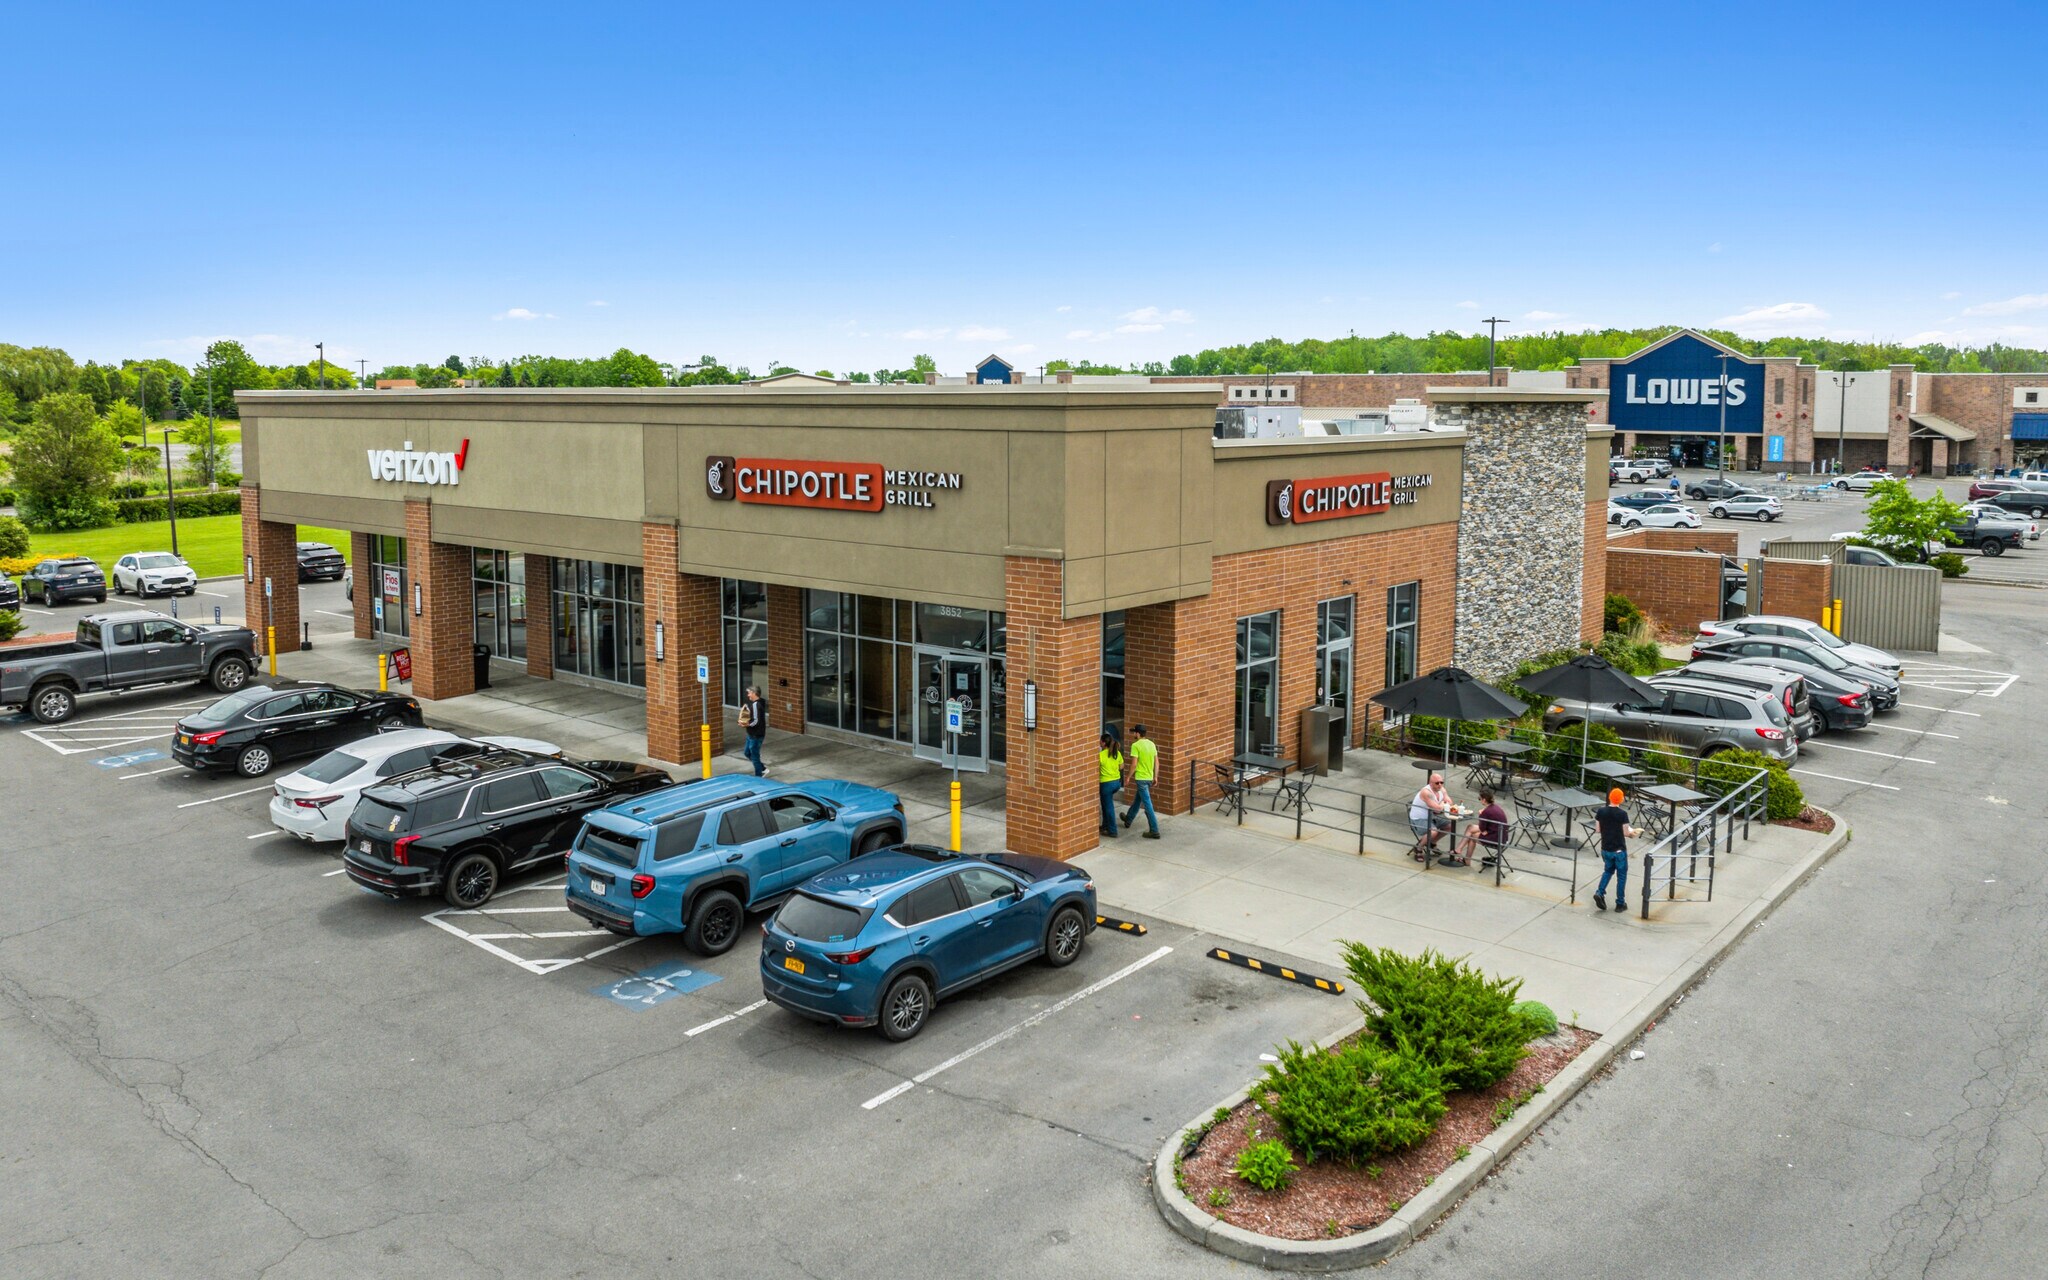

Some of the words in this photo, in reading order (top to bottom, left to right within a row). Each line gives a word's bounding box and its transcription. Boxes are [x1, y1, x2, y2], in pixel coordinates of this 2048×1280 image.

[367, 440, 459, 485] verizon
[738, 467, 871, 501] CHIPOTLE
[885, 470, 962, 489] MEXICAN
[1394, 474, 1433, 489] MEXICAN
[885, 490, 934, 507] GRILL
[1302, 481, 1391, 514] CHIPOTLE
[1393, 491, 1418, 505] GRILL
[385, 573, 398, 585] Fios
[940, 605, 962, 618] 3852
[396, 653, 405, 662] RED
[400, 658, 410, 667] HOT
